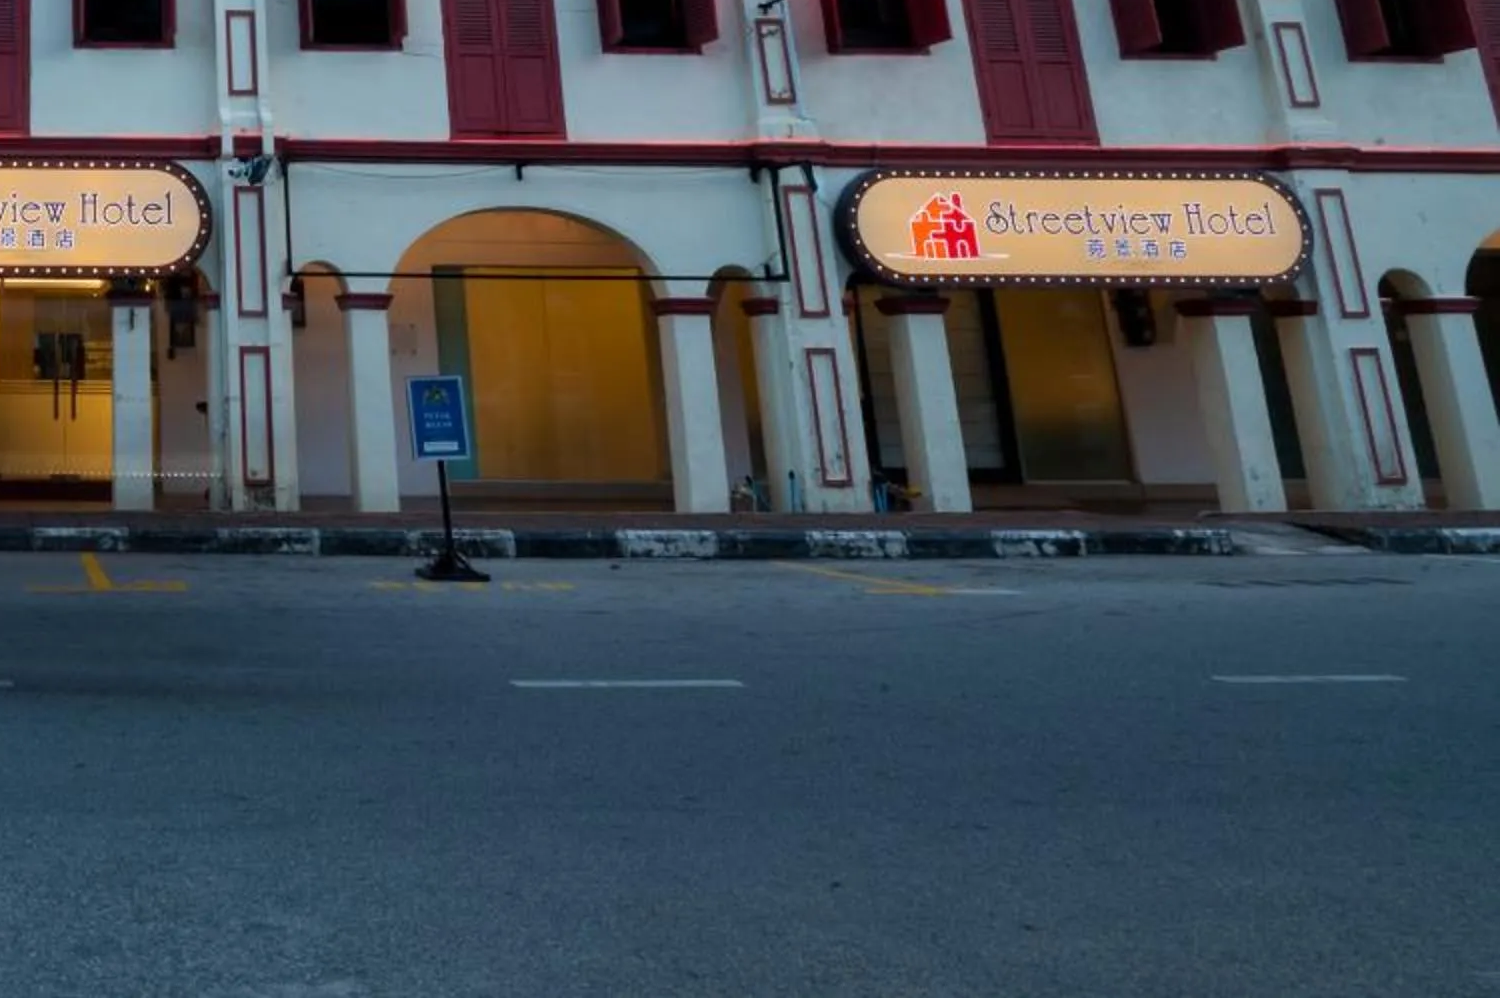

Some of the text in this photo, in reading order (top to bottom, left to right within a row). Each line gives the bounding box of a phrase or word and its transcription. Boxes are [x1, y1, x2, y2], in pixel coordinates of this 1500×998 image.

[79, 191, 173, 225] Hotel
[986, 202, 1276, 236] Streetview Hotel
